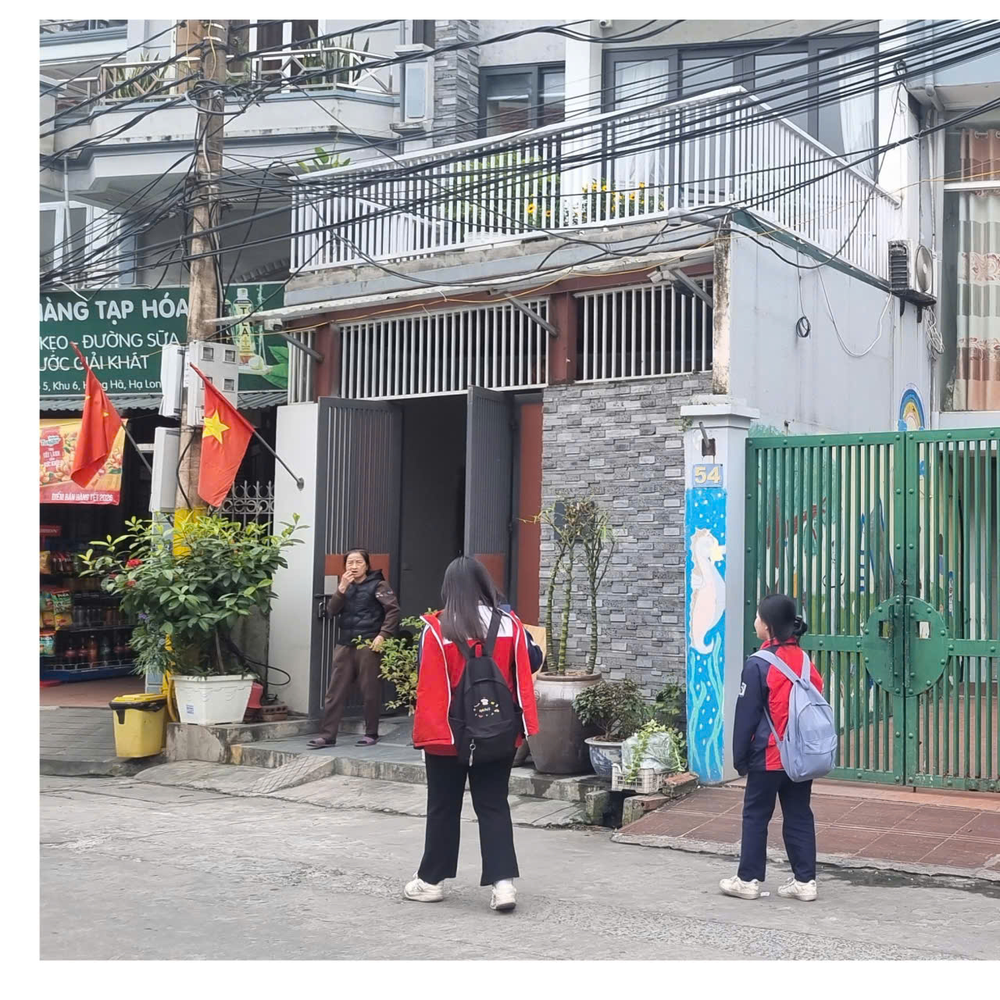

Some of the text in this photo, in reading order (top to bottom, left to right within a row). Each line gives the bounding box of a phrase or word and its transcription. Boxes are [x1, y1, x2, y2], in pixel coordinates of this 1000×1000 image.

[94, 299, 134, 326] TẠP
[142, 291, 189, 319] HÓA
[82, 330, 144, 349] ĐƯỜNG
[147, 329, 180, 348] SỮA
[108, 351, 150, 370] KHÁT
[52, 380, 71, 391] Khu
[72, 380, 81, 391] 6,
[110, 380, 127, 390] Hà,
[128, 379, 143, 389] Hạ
[144, 379, 162, 389] Lon
[694, 466, 721, 484] 54
